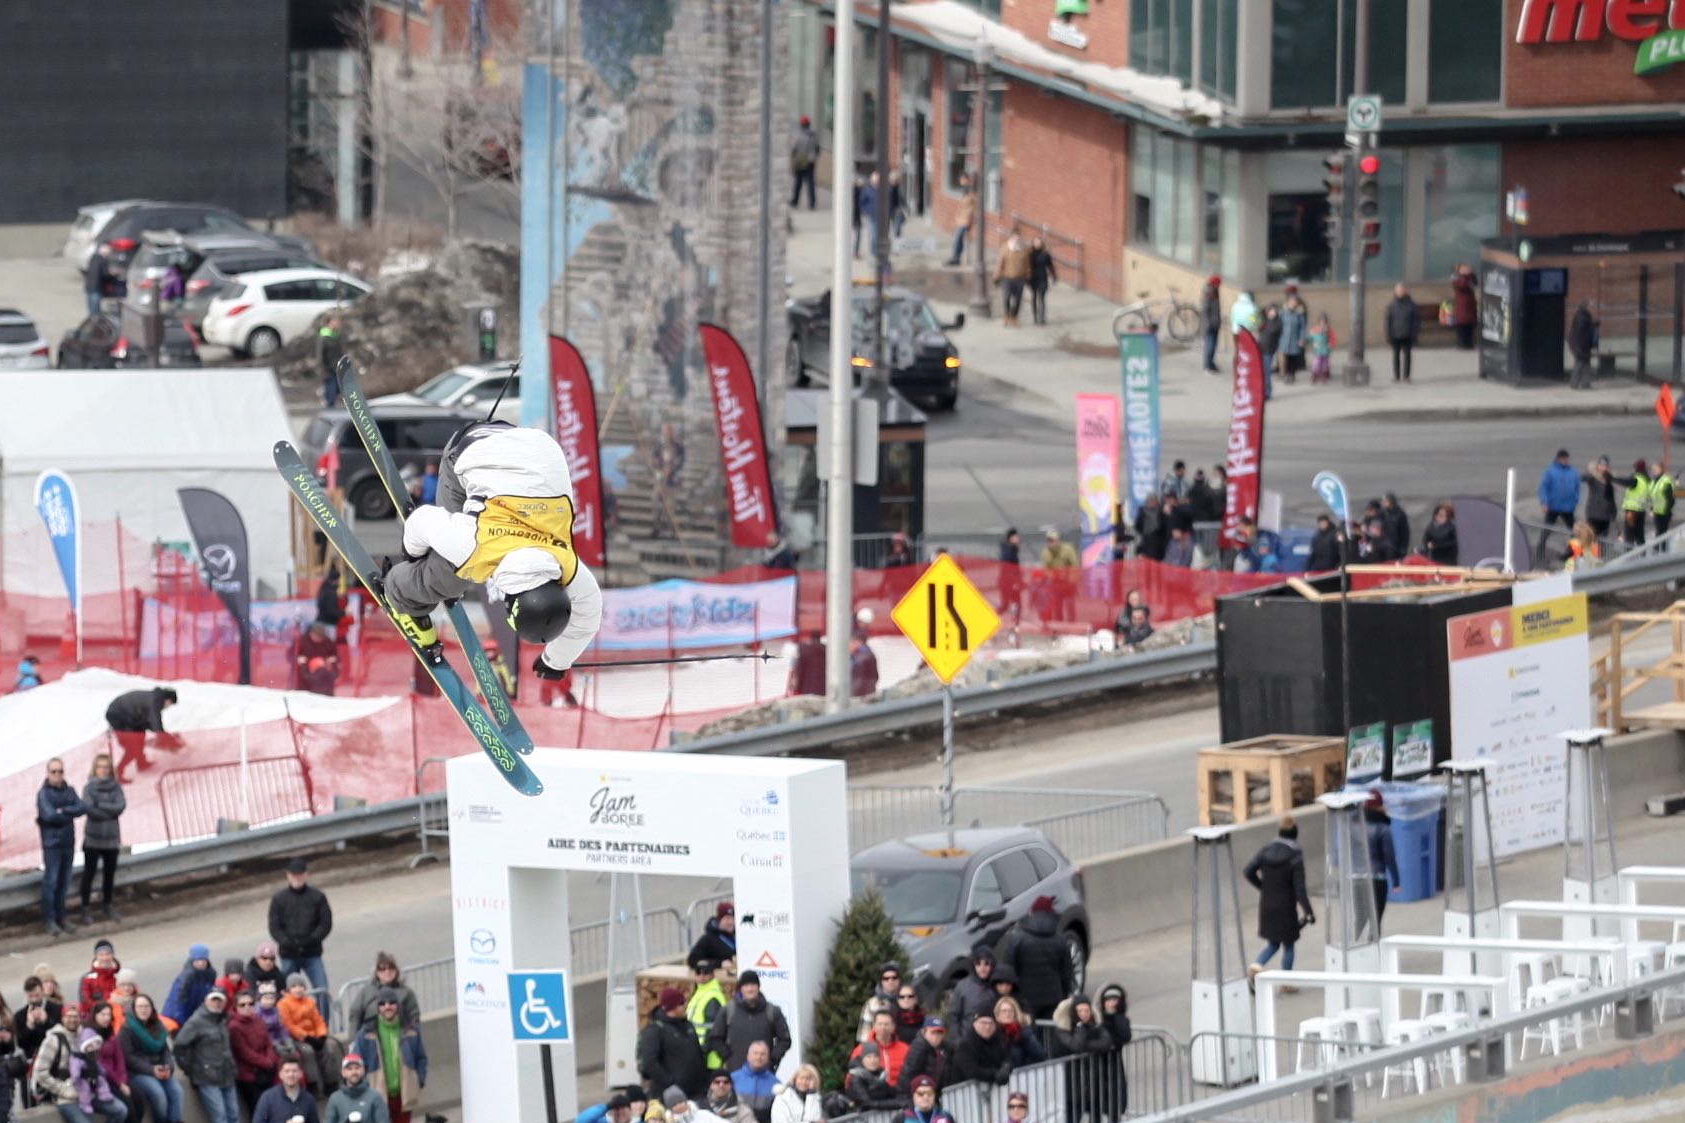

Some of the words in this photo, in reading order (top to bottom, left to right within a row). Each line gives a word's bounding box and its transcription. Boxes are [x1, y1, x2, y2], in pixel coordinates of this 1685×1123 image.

[294, 473, 338, 529] POACHER
[1521, 609, 1551, 624] MERCI
[589, 785, 637, 824] Jam
[547, 838, 576, 851] AIRE
[579, 840, 602, 851] DES
[605, 841, 691, 856] PARTENAIRES
[586, 853, 628, 865] PARTNERS
[630, 855, 652, 866] AREA
